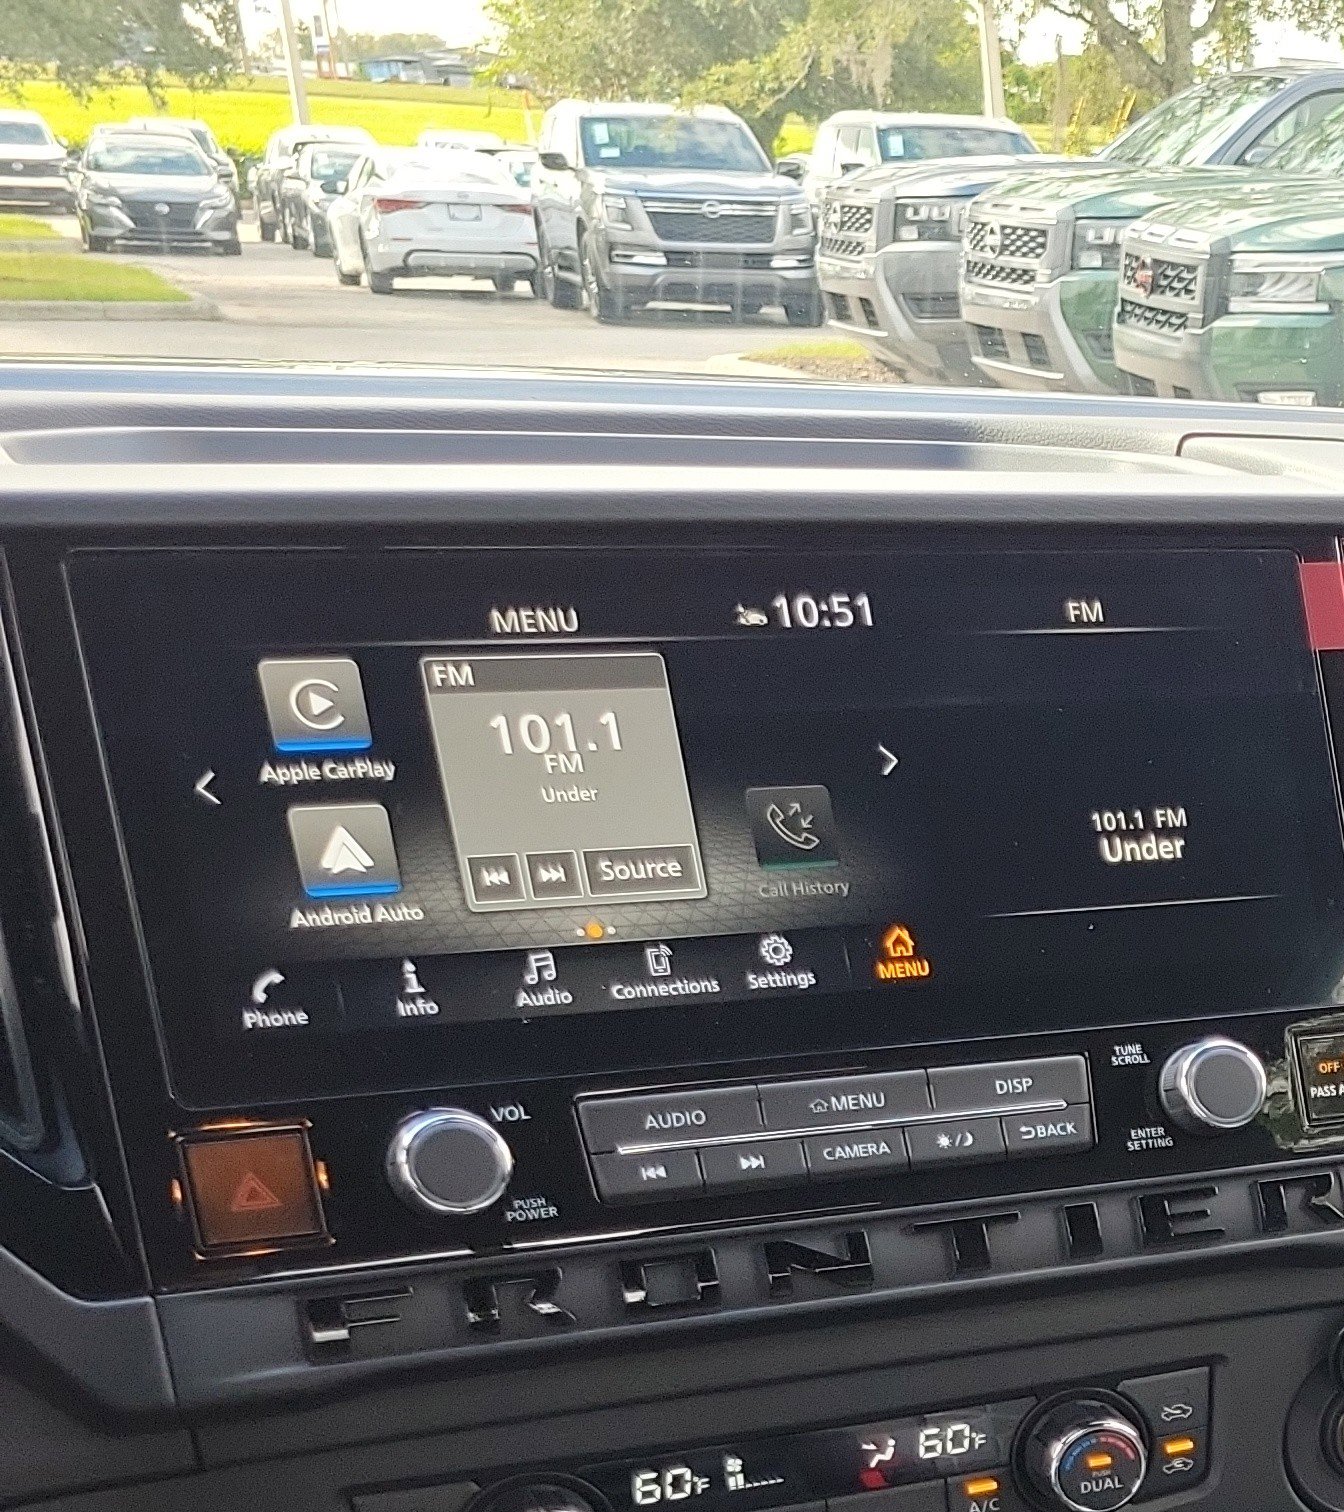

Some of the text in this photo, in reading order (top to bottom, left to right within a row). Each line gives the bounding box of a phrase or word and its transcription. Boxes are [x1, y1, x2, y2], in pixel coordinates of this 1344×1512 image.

[491, 608, 579, 633] MENU
[774, 594, 874, 629] 10:51
[1067, 601, 1104, 624] FM
[432, 665, 474, 688] FM
[490, 712, 624, 755] 101.1
[260, 760, 397, 785] Apple CarPlay
[544, 754, 584, 774] FM
[541, 785, 599, 803] Under
[1091, 808, 1187, 831] 101.1 FM
[1101, 836, 1185, 863] Under
[600, 857, 682, 879] Source
[758, 878, 850, 898] Call History
[290, 903, 425, 928] Android Auto
[748, 969, 817, 990] Settings
[877, 960, 930, 980] MENU
[517, 987, 573, 1008] Audio
[611, 978, 720, 1000] Connections
[398, 998, 439, 1017] Info
[243, 1007, 309, 1029] Phone
[1111, 1054, 1151, 1066] SCROLL
[1114, 1044, 1143, 1056] TUNE
[1319, 1061, 1341, 1075] OFF
[995, 1077, 1034, 1095] DISP
[1311, 1085, 1337, 1098] PASS
[832, 1093, 886, 1112] MENU
[491, 1104, 531, 1122] VOL
[645, 1110, 707, 1131] AUDIO
[1036, 1121, 1077, 1139] BACK
[1131, 1127, 1165, 1140] ENTER
[823, 1141, 891, 1162] CAMERA
[1127, 1137, 1173, 1152] SETTING
[506, 1205, 559, 1223] POWER
[514, 1197, 548, 1211] PUSH
[1080, 1476, 1124, 1494] DUAL
